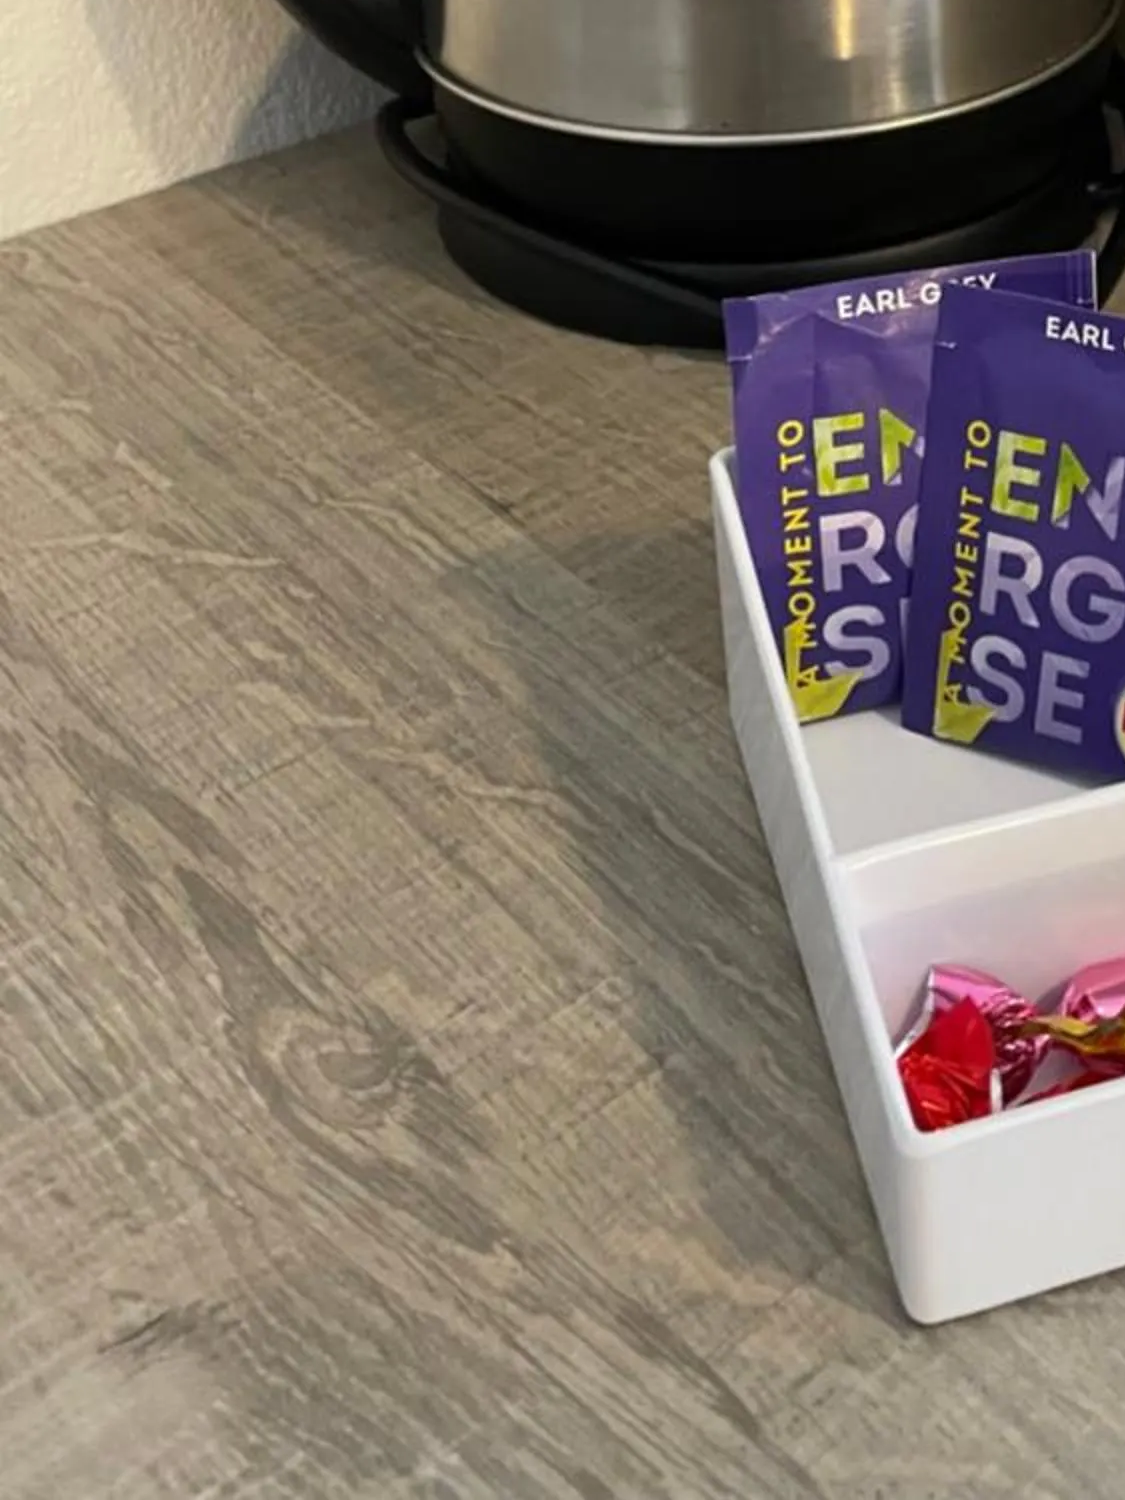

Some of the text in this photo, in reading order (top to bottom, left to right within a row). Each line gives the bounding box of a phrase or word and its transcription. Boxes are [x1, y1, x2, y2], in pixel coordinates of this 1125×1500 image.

[836, 272, 997, 320] EARL GEY
[1045, 315, 1116, 351] EARL
[812, 407, 926, 497] EN
[777, 419, 820, 689] A MOMENT TO
[943, 419, 993, 704] A MOMENT TO
[964, 634, 1092, 745] SE
